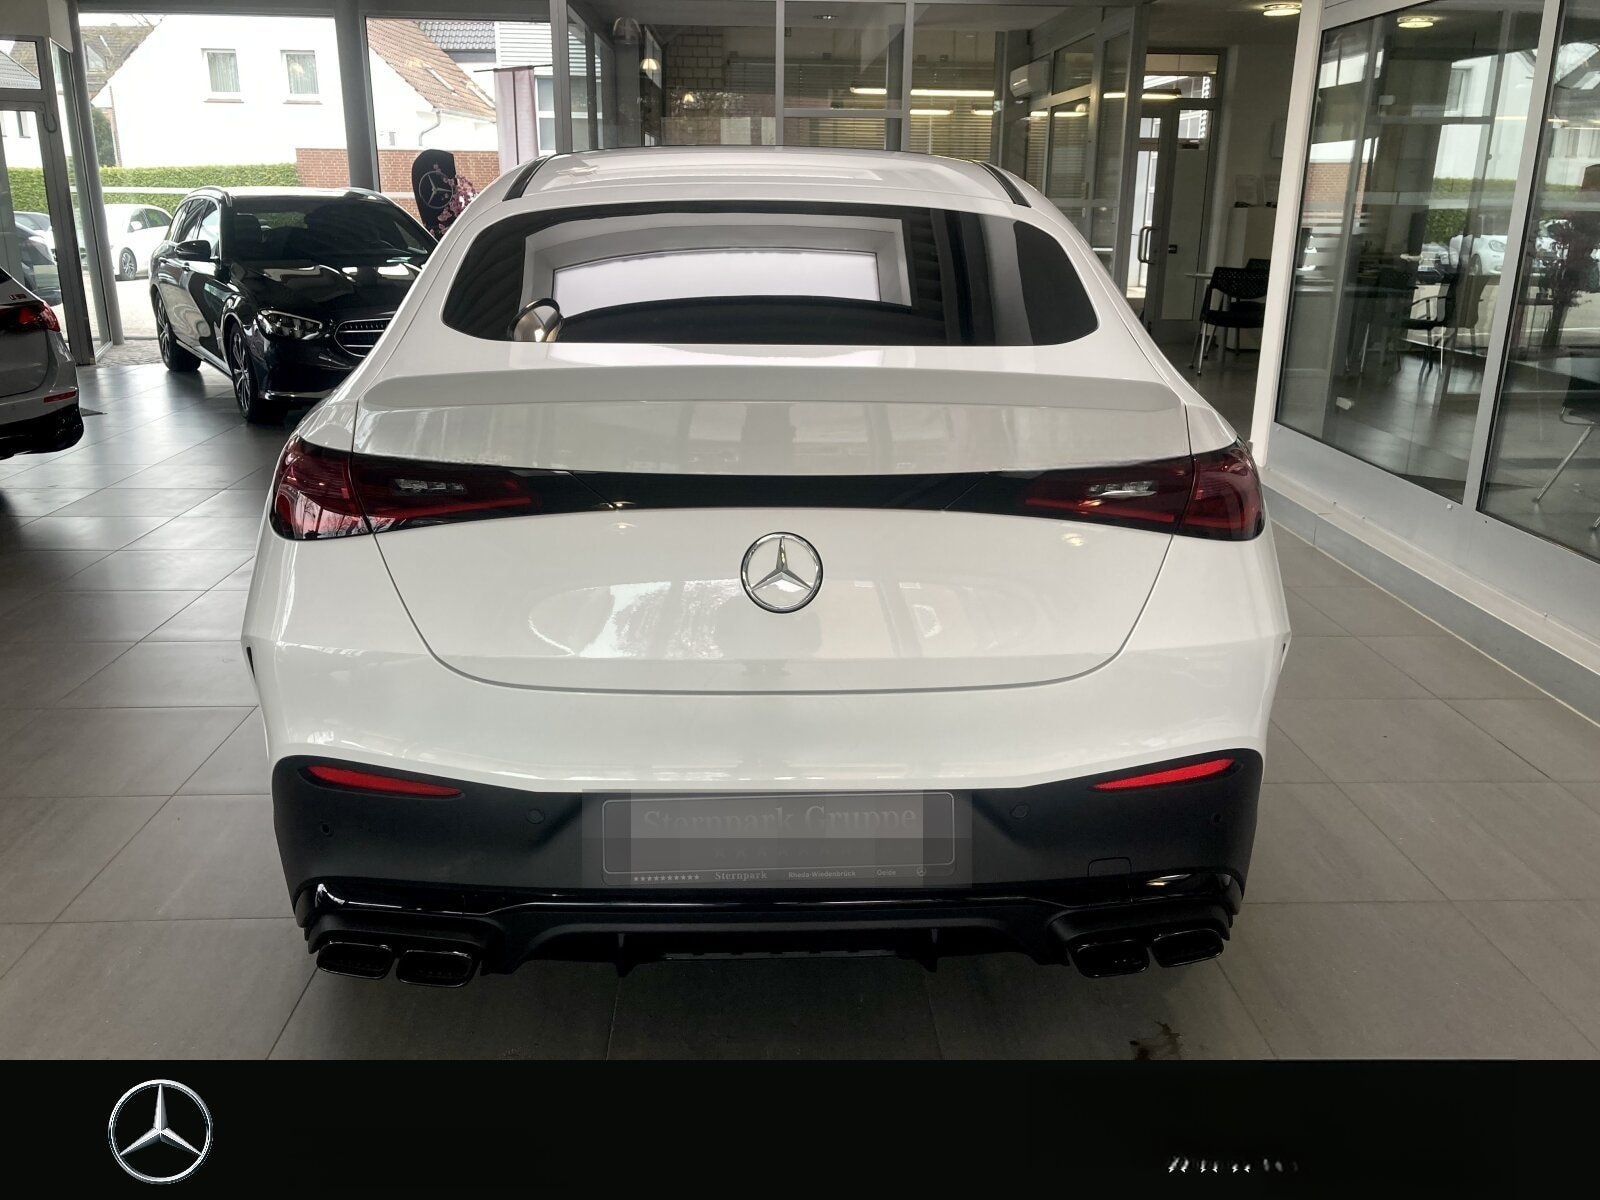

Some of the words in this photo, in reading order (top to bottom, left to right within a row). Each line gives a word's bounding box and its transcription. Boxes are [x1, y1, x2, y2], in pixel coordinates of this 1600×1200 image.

[643, 806, 793, 836] Sternpark
[804, 804, 917, 835] Gruppe
[714, 870, 769, 881] Sternpark
